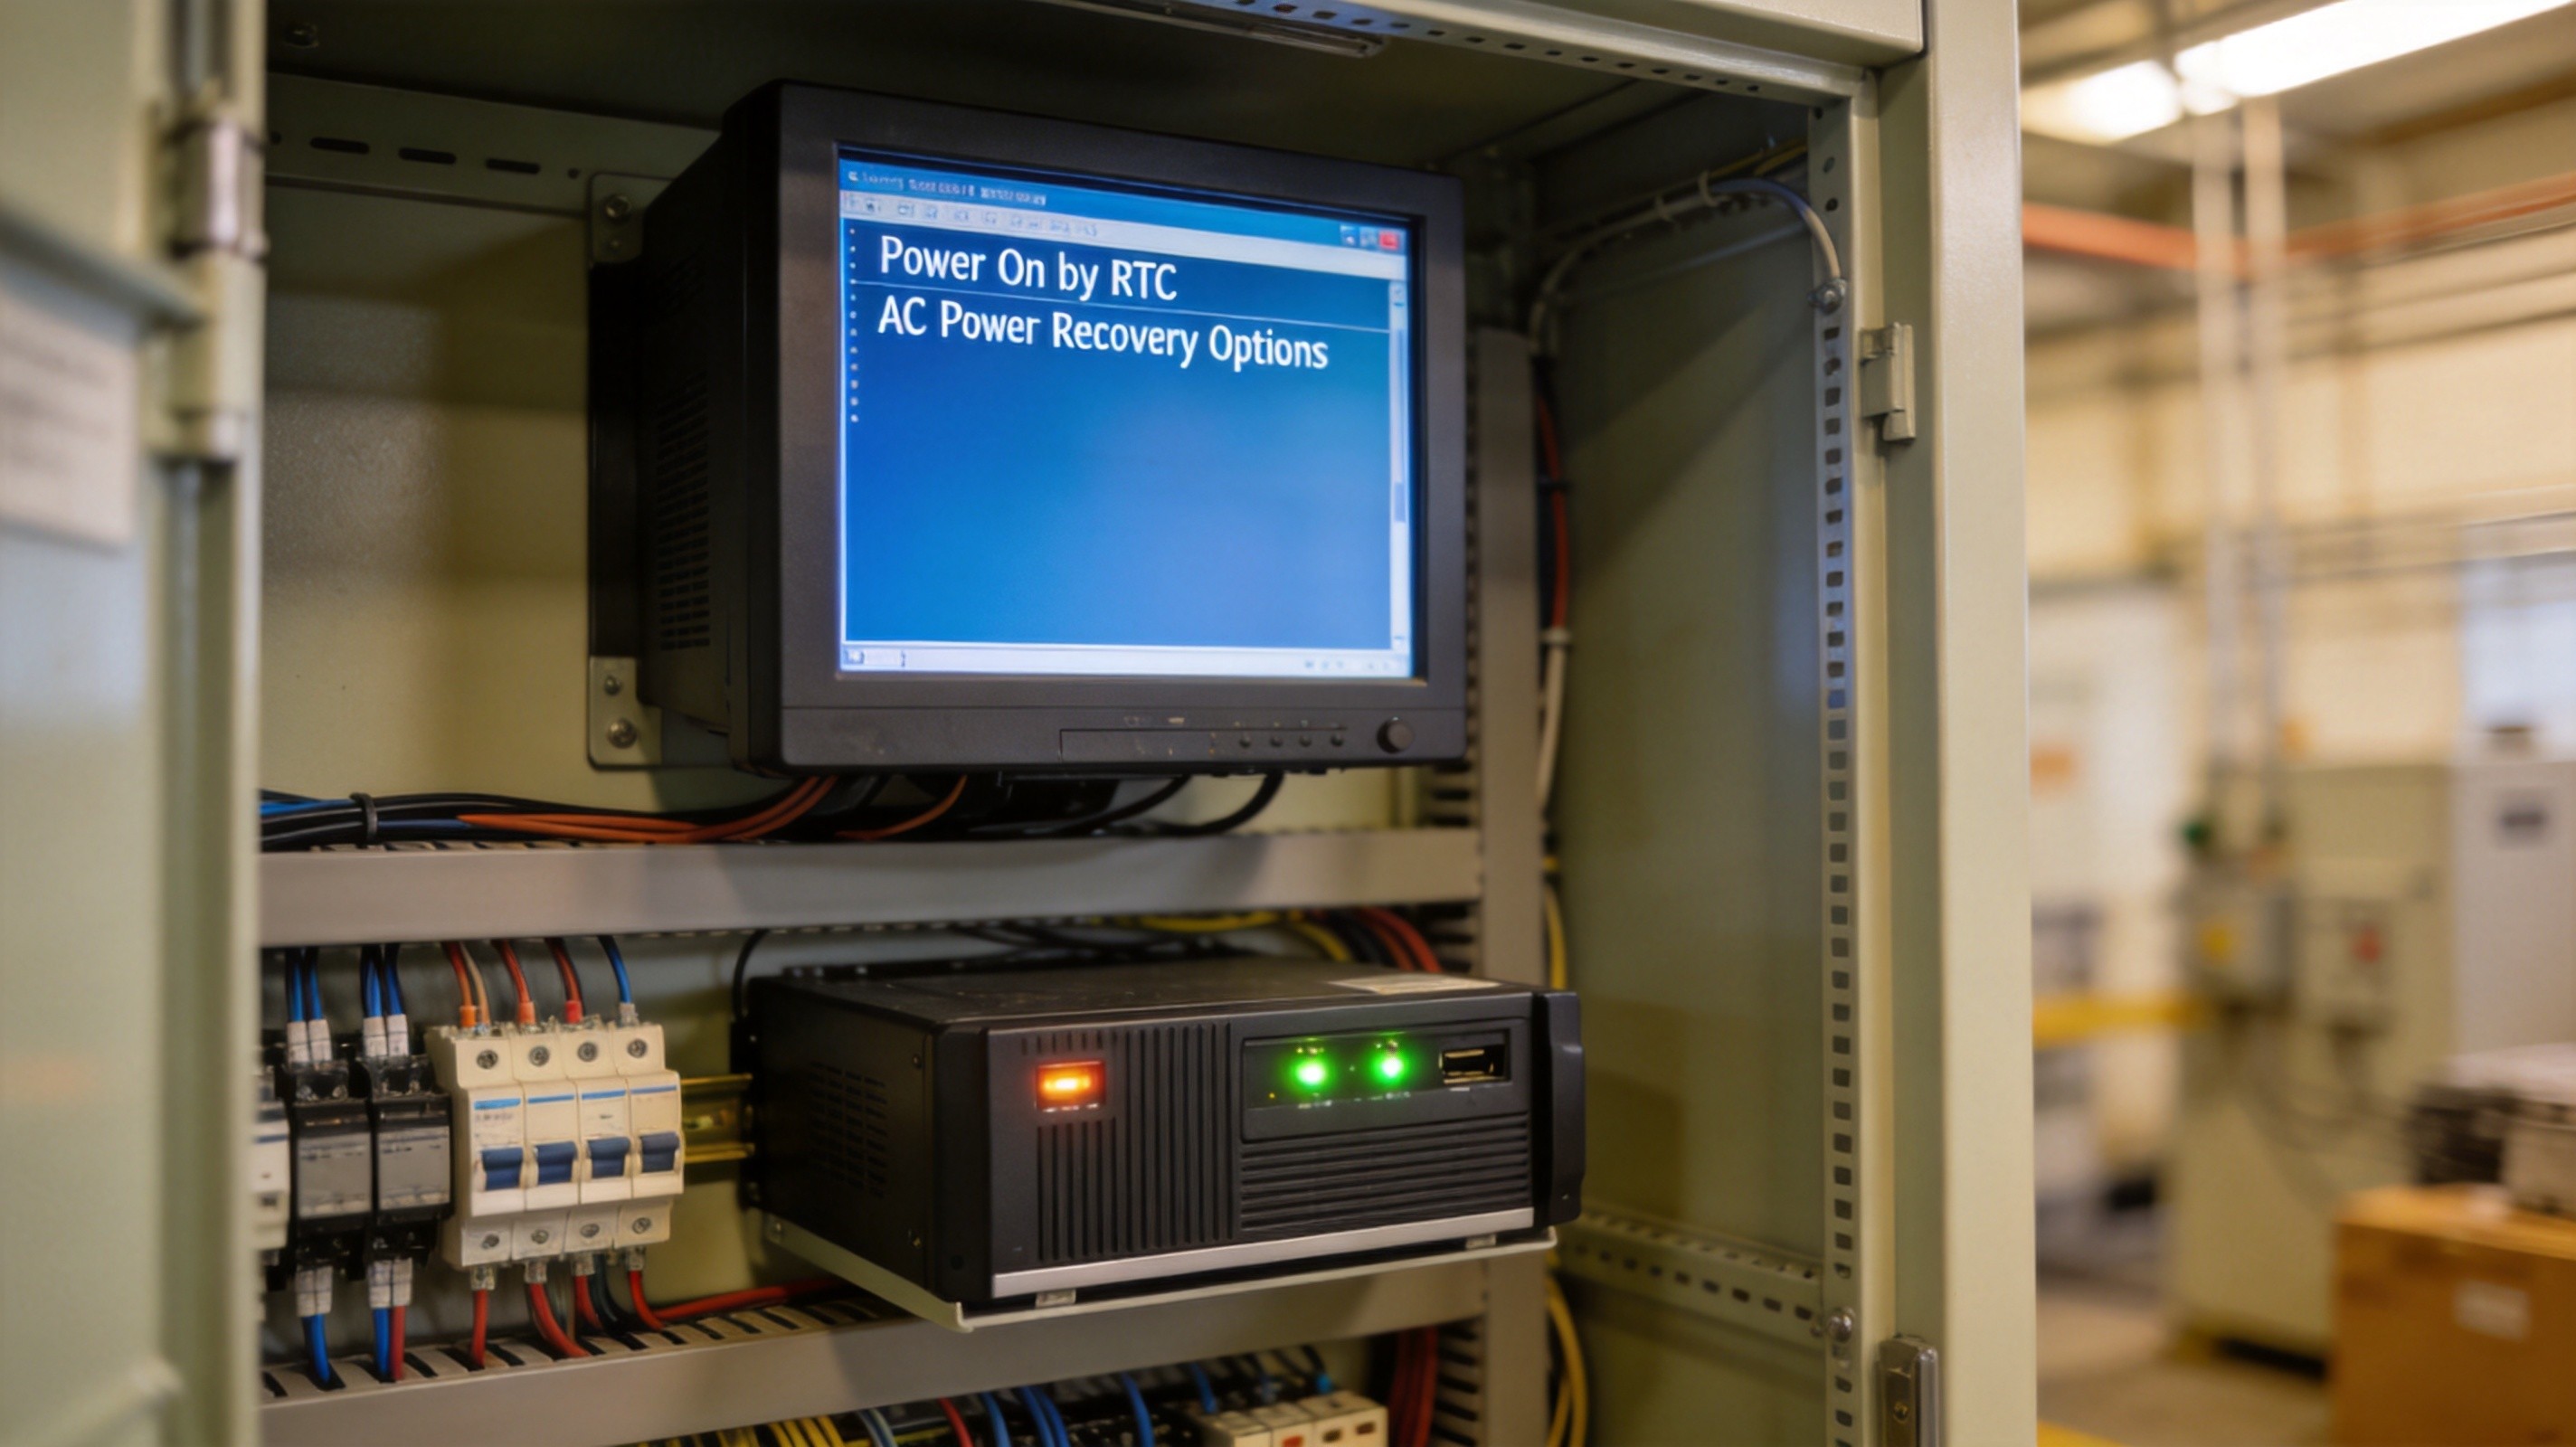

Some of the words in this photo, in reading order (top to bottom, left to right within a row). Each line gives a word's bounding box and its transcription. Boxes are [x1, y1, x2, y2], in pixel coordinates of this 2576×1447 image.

[880, 235, 987, 281] Power
[998, 248, 1045, 288] On
[1058, 251, 1099, 302] by
[1112, 259, 1178, 301] RTC
[878, 295, 926, 336] AC
[941, 299, 1040, 345] Power
[1053, 311, 1198, 369] Recovery
[1209, 325, 1329, 373] Options
